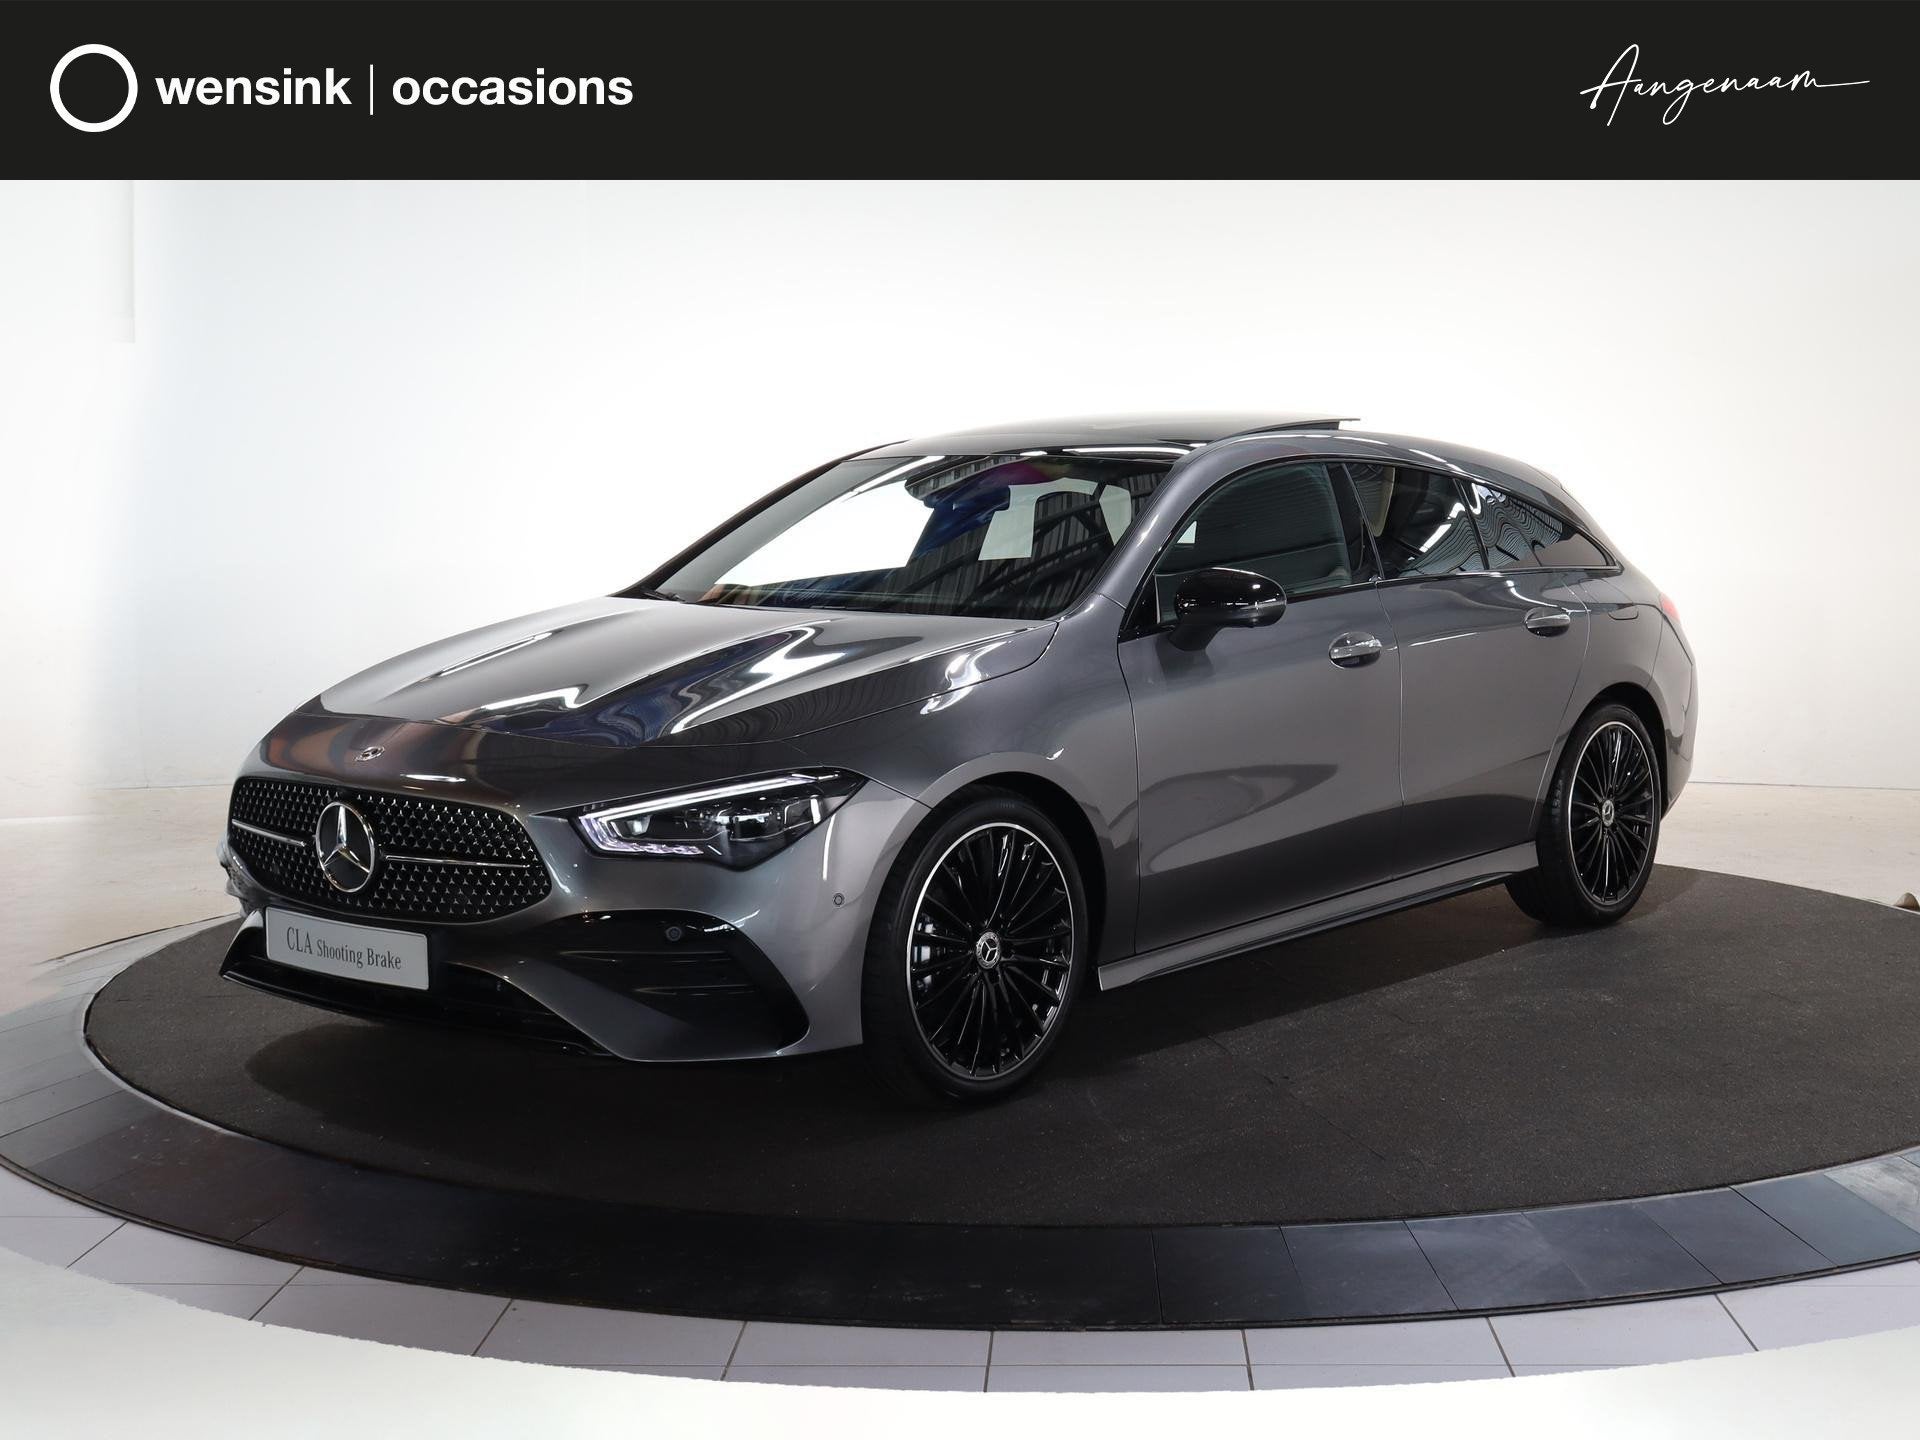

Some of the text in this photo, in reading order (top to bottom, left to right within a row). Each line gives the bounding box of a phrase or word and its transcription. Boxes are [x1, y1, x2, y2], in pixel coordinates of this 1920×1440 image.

[286, 926, 402, 970] CLA Shooting Brake
